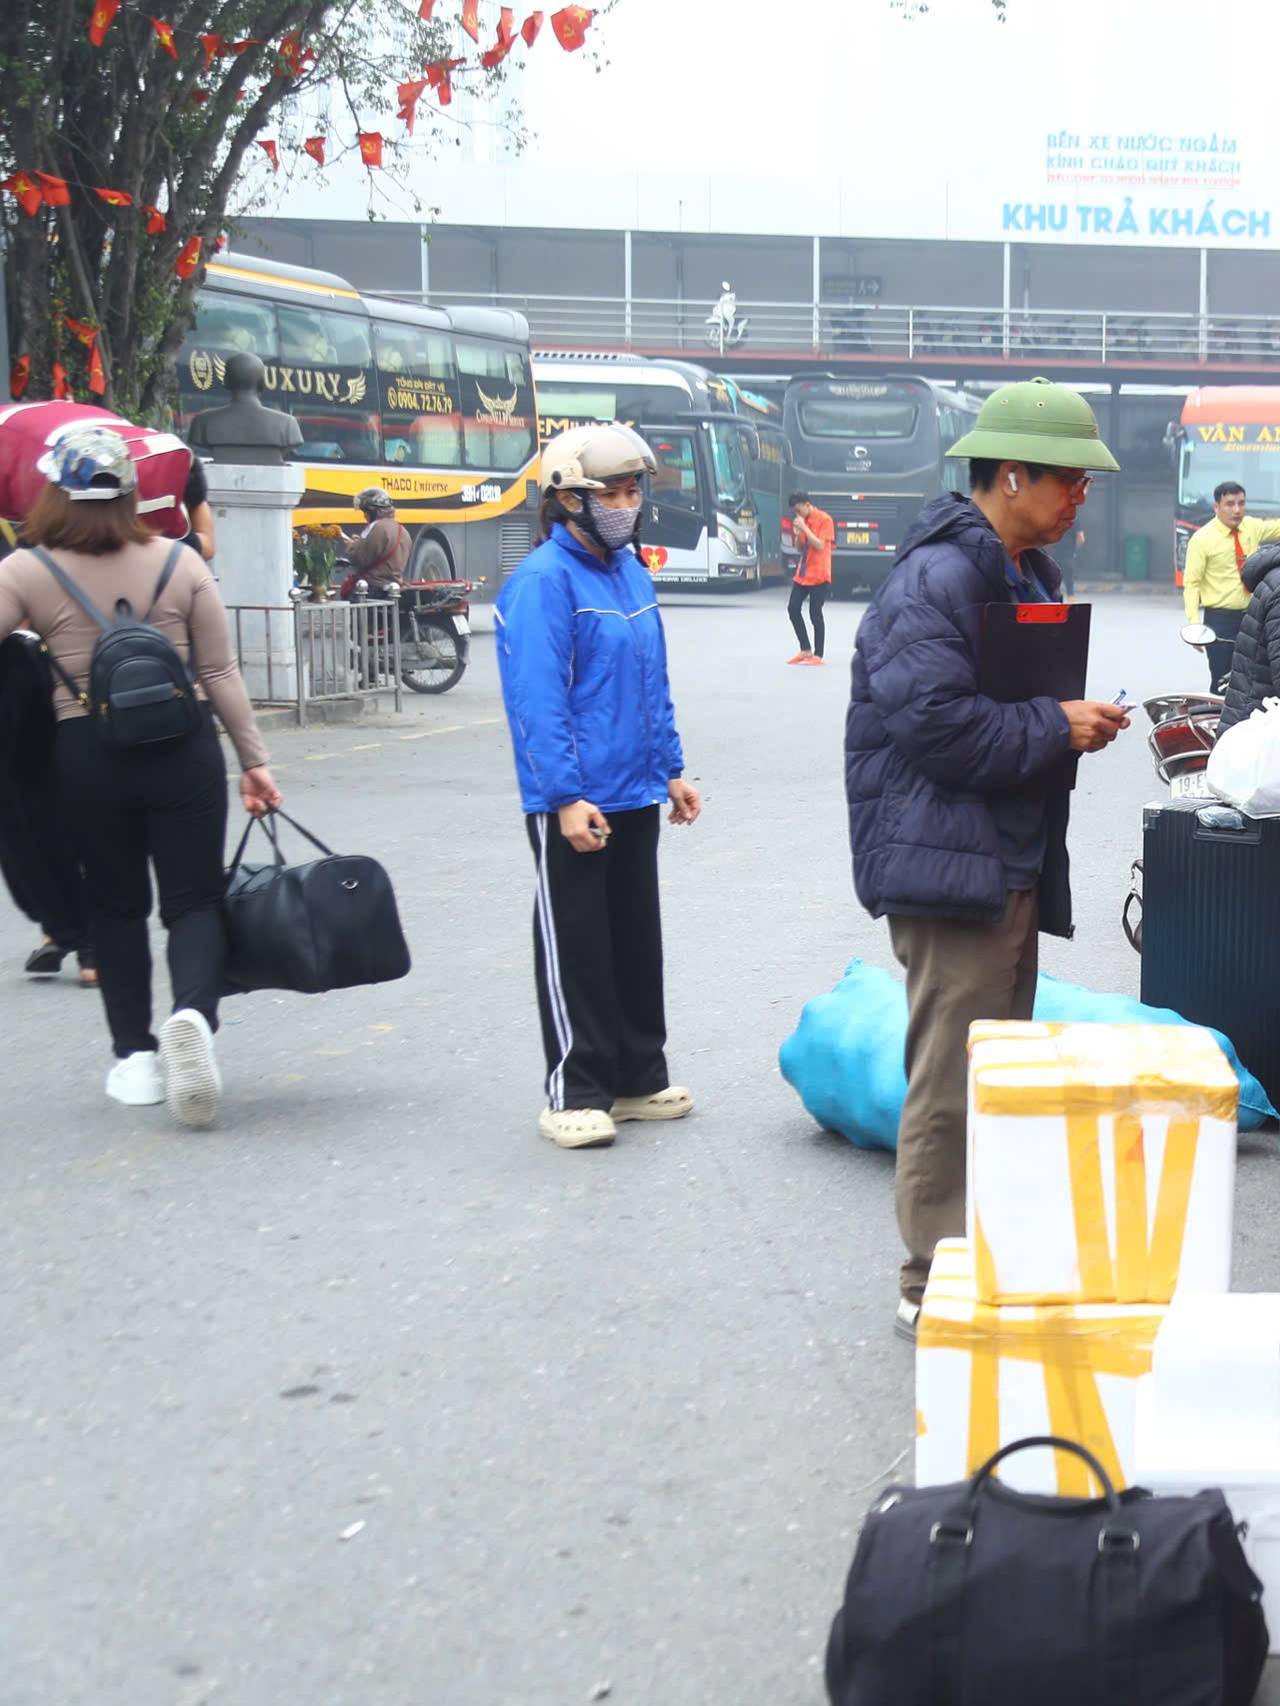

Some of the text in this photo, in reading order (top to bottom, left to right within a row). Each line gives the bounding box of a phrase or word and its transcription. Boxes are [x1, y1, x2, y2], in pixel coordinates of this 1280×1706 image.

[1089, 135, 1111, 150] XE
[1002, 196, 1271, 237] KHU TRẢ KHÁCH
[263, 365, 342, 401] UXURY
[1198, 422, 1245, 443] VÂN
[381, 477, 412, 491] THACO
